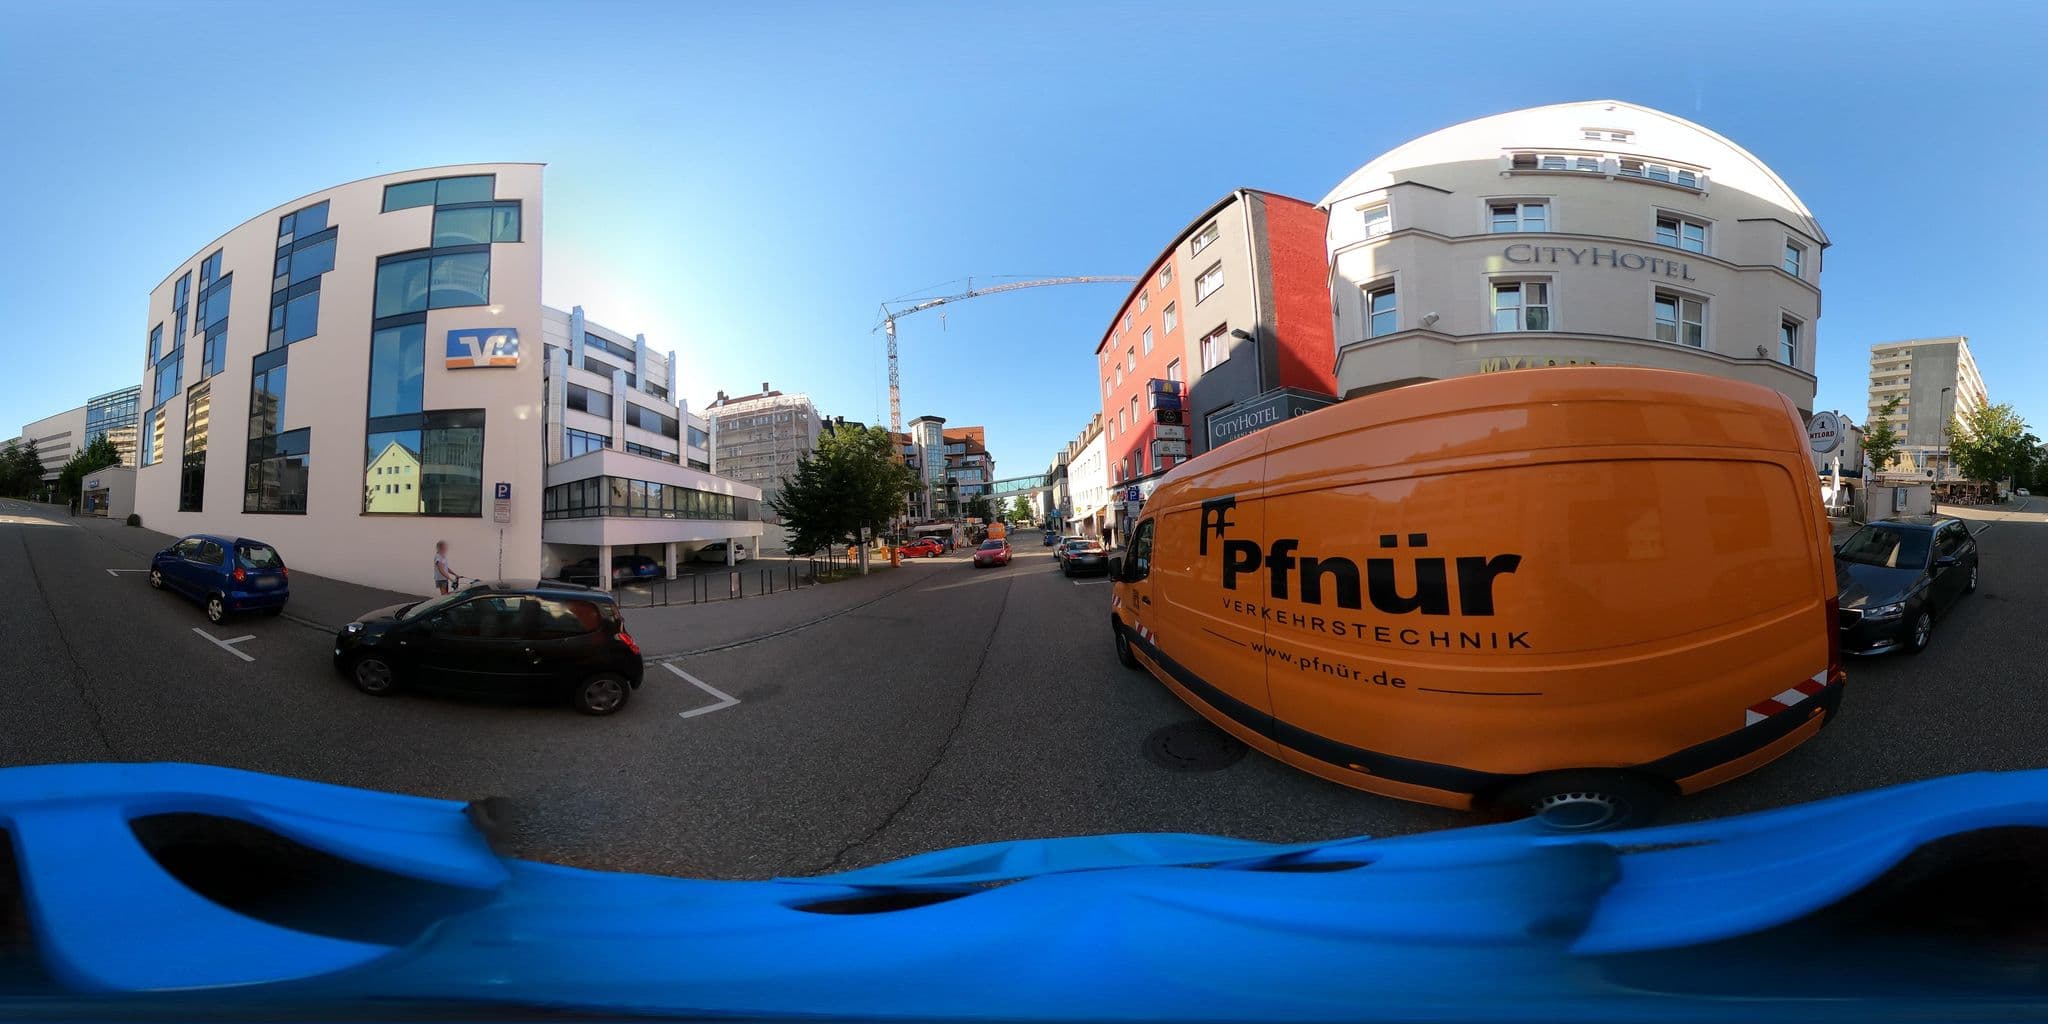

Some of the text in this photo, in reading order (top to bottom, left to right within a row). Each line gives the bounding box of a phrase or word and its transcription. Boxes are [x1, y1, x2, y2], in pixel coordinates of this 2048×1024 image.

[1222, 533, 1523, 616] Pfnür
[1222, 597, 1533, 649] VERKEHRSTECHNIK
[1251, 641, 1407, 689] www.pfnür.de
